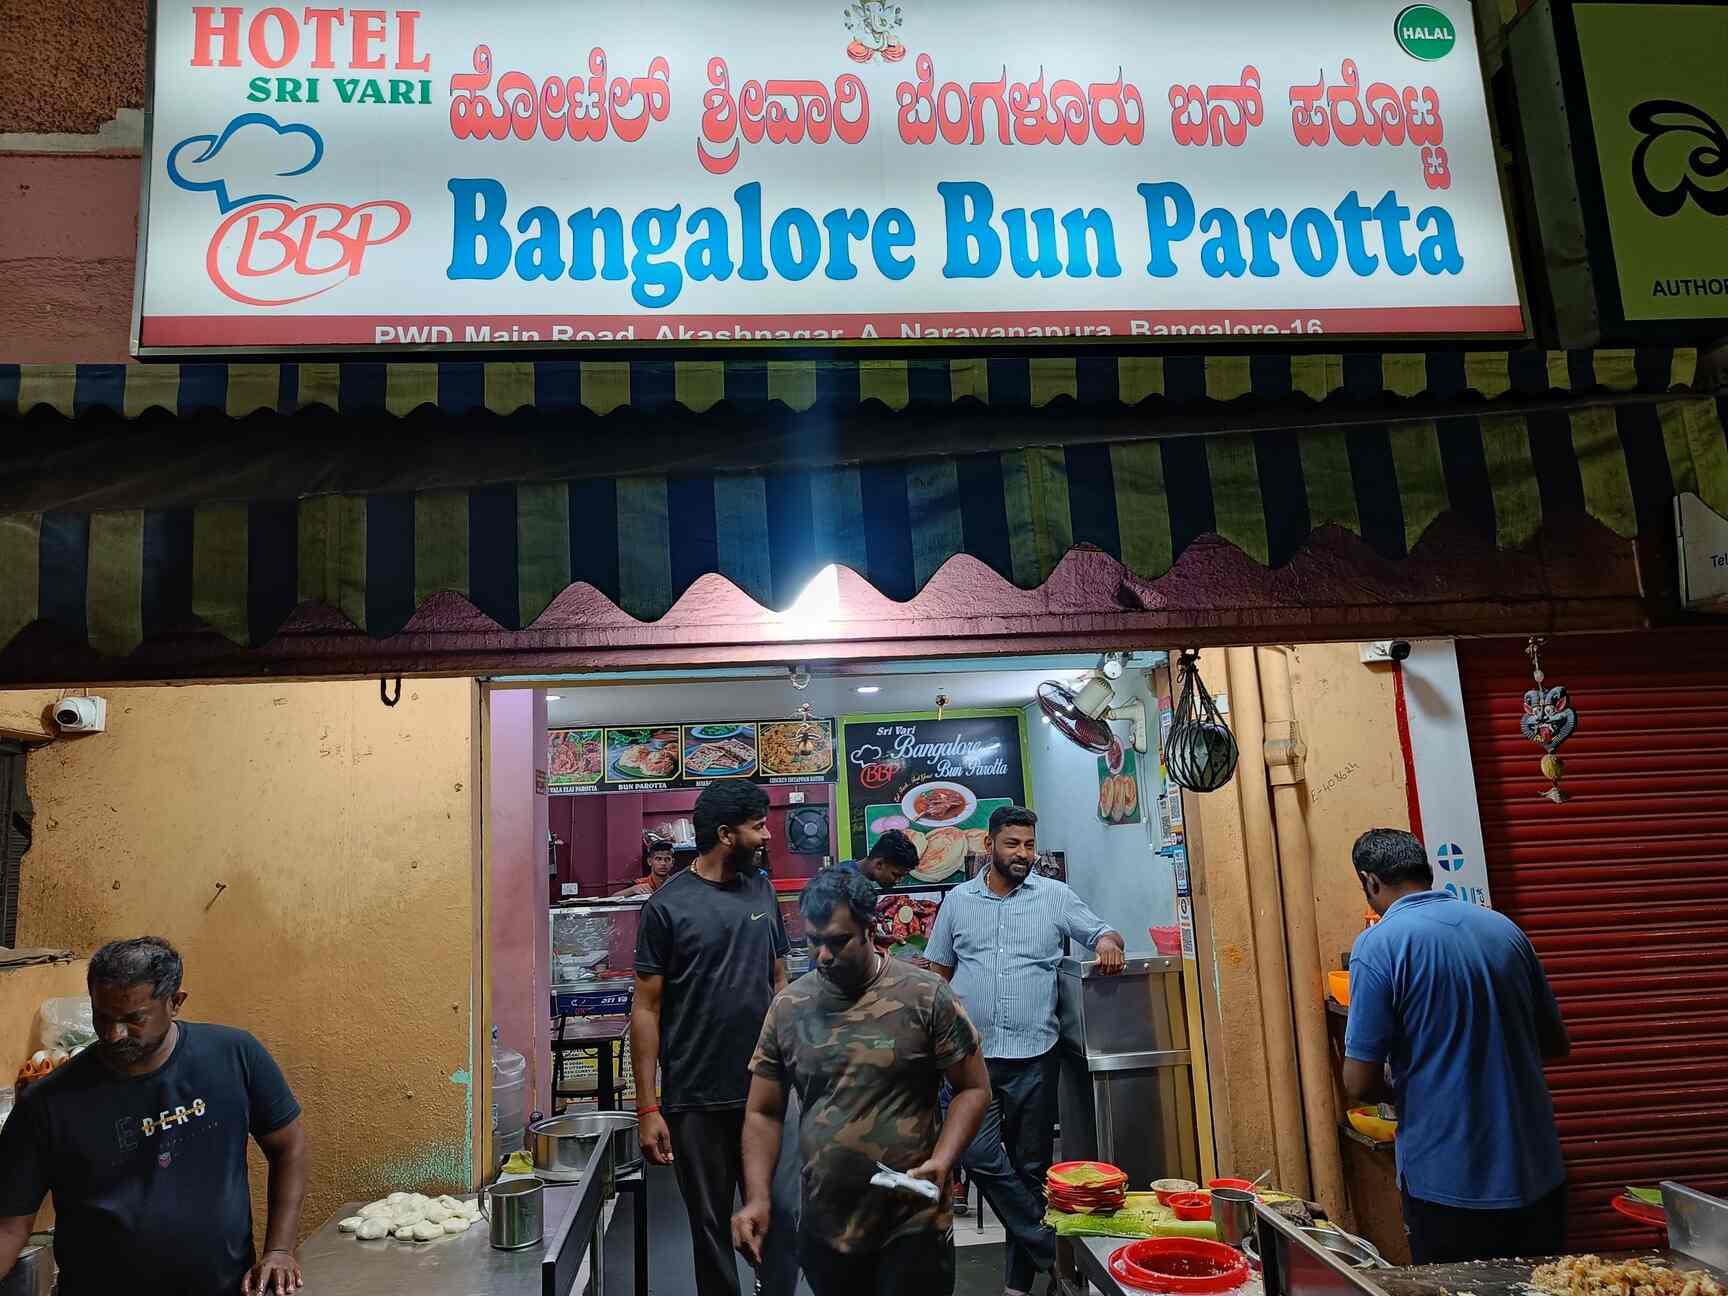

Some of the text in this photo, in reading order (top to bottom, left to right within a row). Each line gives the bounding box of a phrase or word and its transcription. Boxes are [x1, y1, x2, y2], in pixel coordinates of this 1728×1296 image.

[190, 7, 432, 72] HOTEL
[1402, 26, 1453, 41] HALAL
[246, 77, 433, 104] SRI VARI
[449, 44, 670, 143] ಹೋಟೆಲ್
[697, 56, 870, 175] ಶ್ರೀವಾರಿ
[896, 53, 1145, 147] ಬೆಂಗಳೂರು
[1168, 65, 1264, 147] ಬನ್
[215, 200, 412, 290] BBP
[446, 177, 1465, 308] Bangalore Bun Parotta
[375, 325, 453, 344] PWD
[464, 324, 540, 342] Main
[890, 734, 992, 765] Bangalore
[935, 760, 964, 778] Bun
